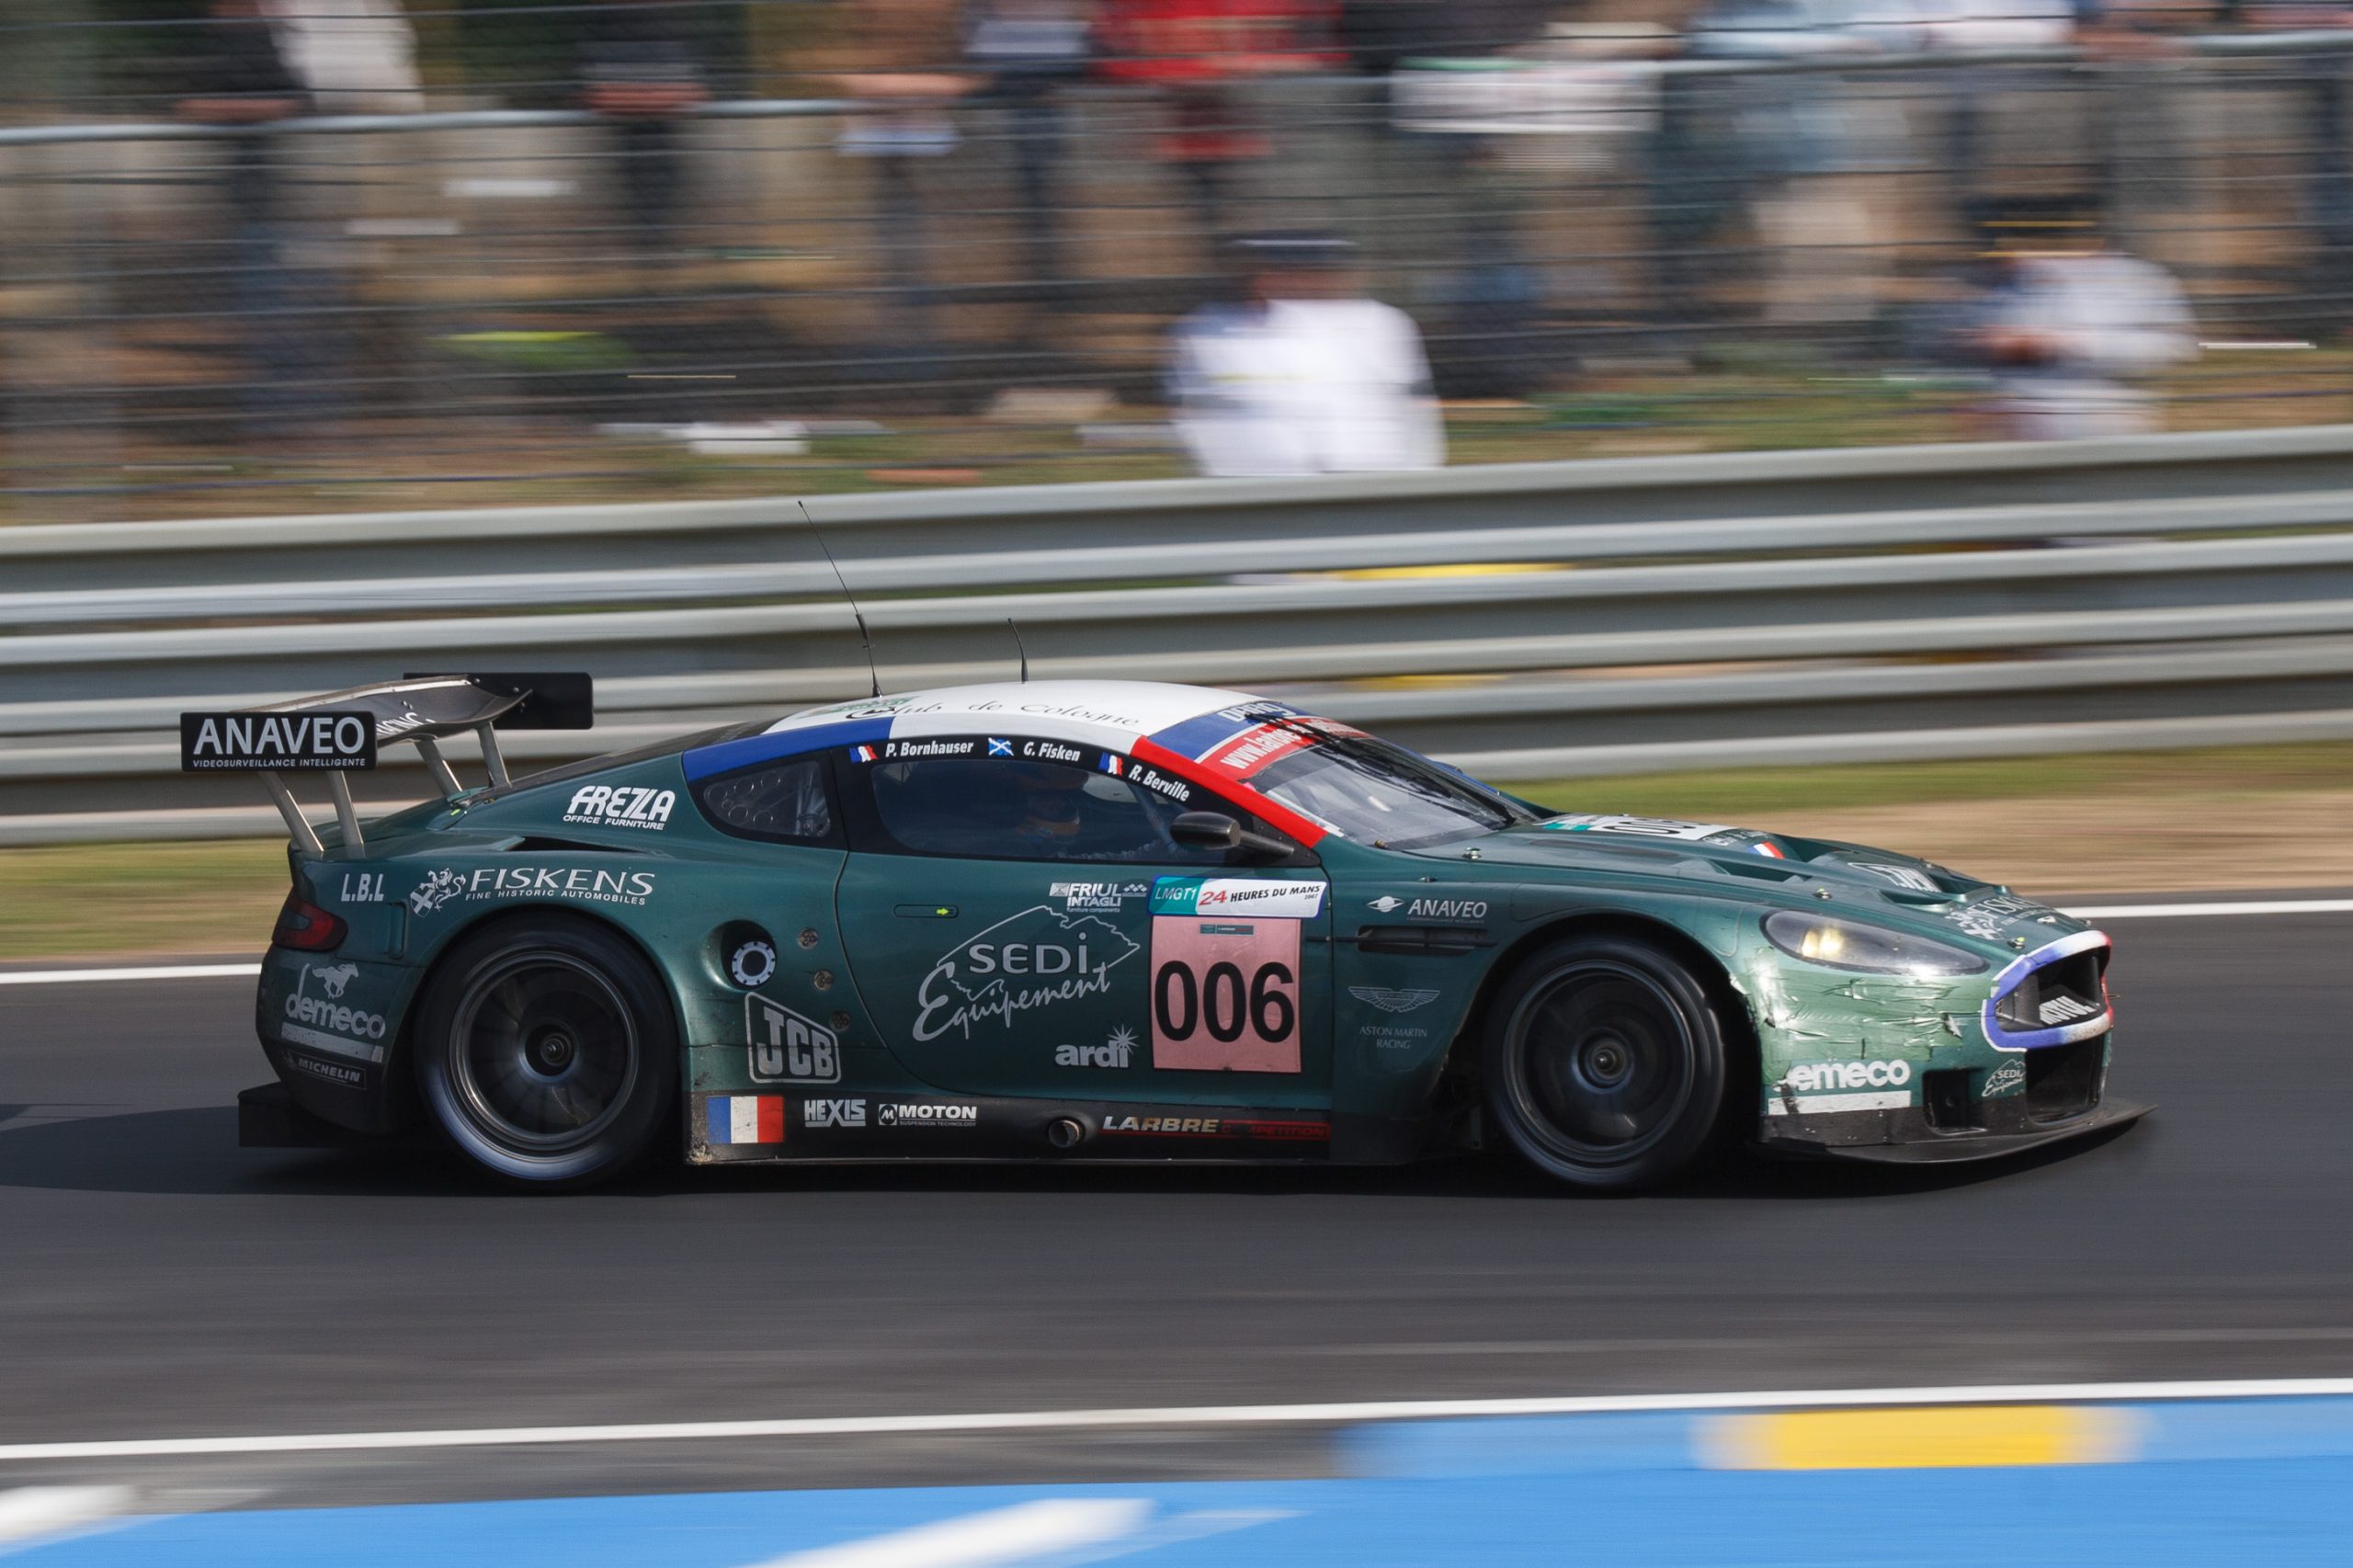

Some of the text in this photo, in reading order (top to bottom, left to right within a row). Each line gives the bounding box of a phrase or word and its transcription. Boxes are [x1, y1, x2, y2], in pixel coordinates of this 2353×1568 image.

[968, 700, 1004, 712] de
[1020, 702, 1140, 726] Cologne
[193, 716, 365, 756] ANAVEO
[885, 740, 974, 757] P. Bornhauser
[1023, 742, 1082, 762] G. Fisken
[193, 757, 366, 768] VIDEOSURVEILLANCE INTELLIGENTE
[1129, 764, 1190, 801] R. Berville
[566, 785, 676, 823] FREZZA
[563, 814, 665, 831] OFFICE FURNITURE
[341, 873, 386, 903] L.B.L
[469, 868, 655, 896] FISKENS
[1069, 882, 1122, 897] FRIUL
[466, 890, 646, 905] FINE HISTORIC AUTOMOBILES
[1066, 896, 1122, 907] INTAGLI
[1154, 886, 1198, 901] LMGT1
[1199, 889, 1228, 905] 24
[1230, 889, 1270, 902] HEURES
[1272, 887, 1288, 898] DU
[1290, 885, 1321, 895] MANS
[1407, 899, 1488, 918] ANAVEO
[285, 963, 386, 1040] demeco
[912, 960, 1111, 1041] Equipement
[1154, 960, 1295, 1044] 006
[756, 1006, 835, 1077] JCB
[1359, 1026, 1427, 1038] ASTON MARTIN
[1055, 1039, 1130, 1068] ardi
[1376, 1039, 1411, 1050] RACING
[298, 1058, 362, 1082] MICHELIN
[1773, 1059, 1911, 1093] emeco
[804, 1098, 867, 1127] HEXIS
[899, 1105, 978, 1119] MOTON
[1103, 1115, 1221, 1133] LARBRE
